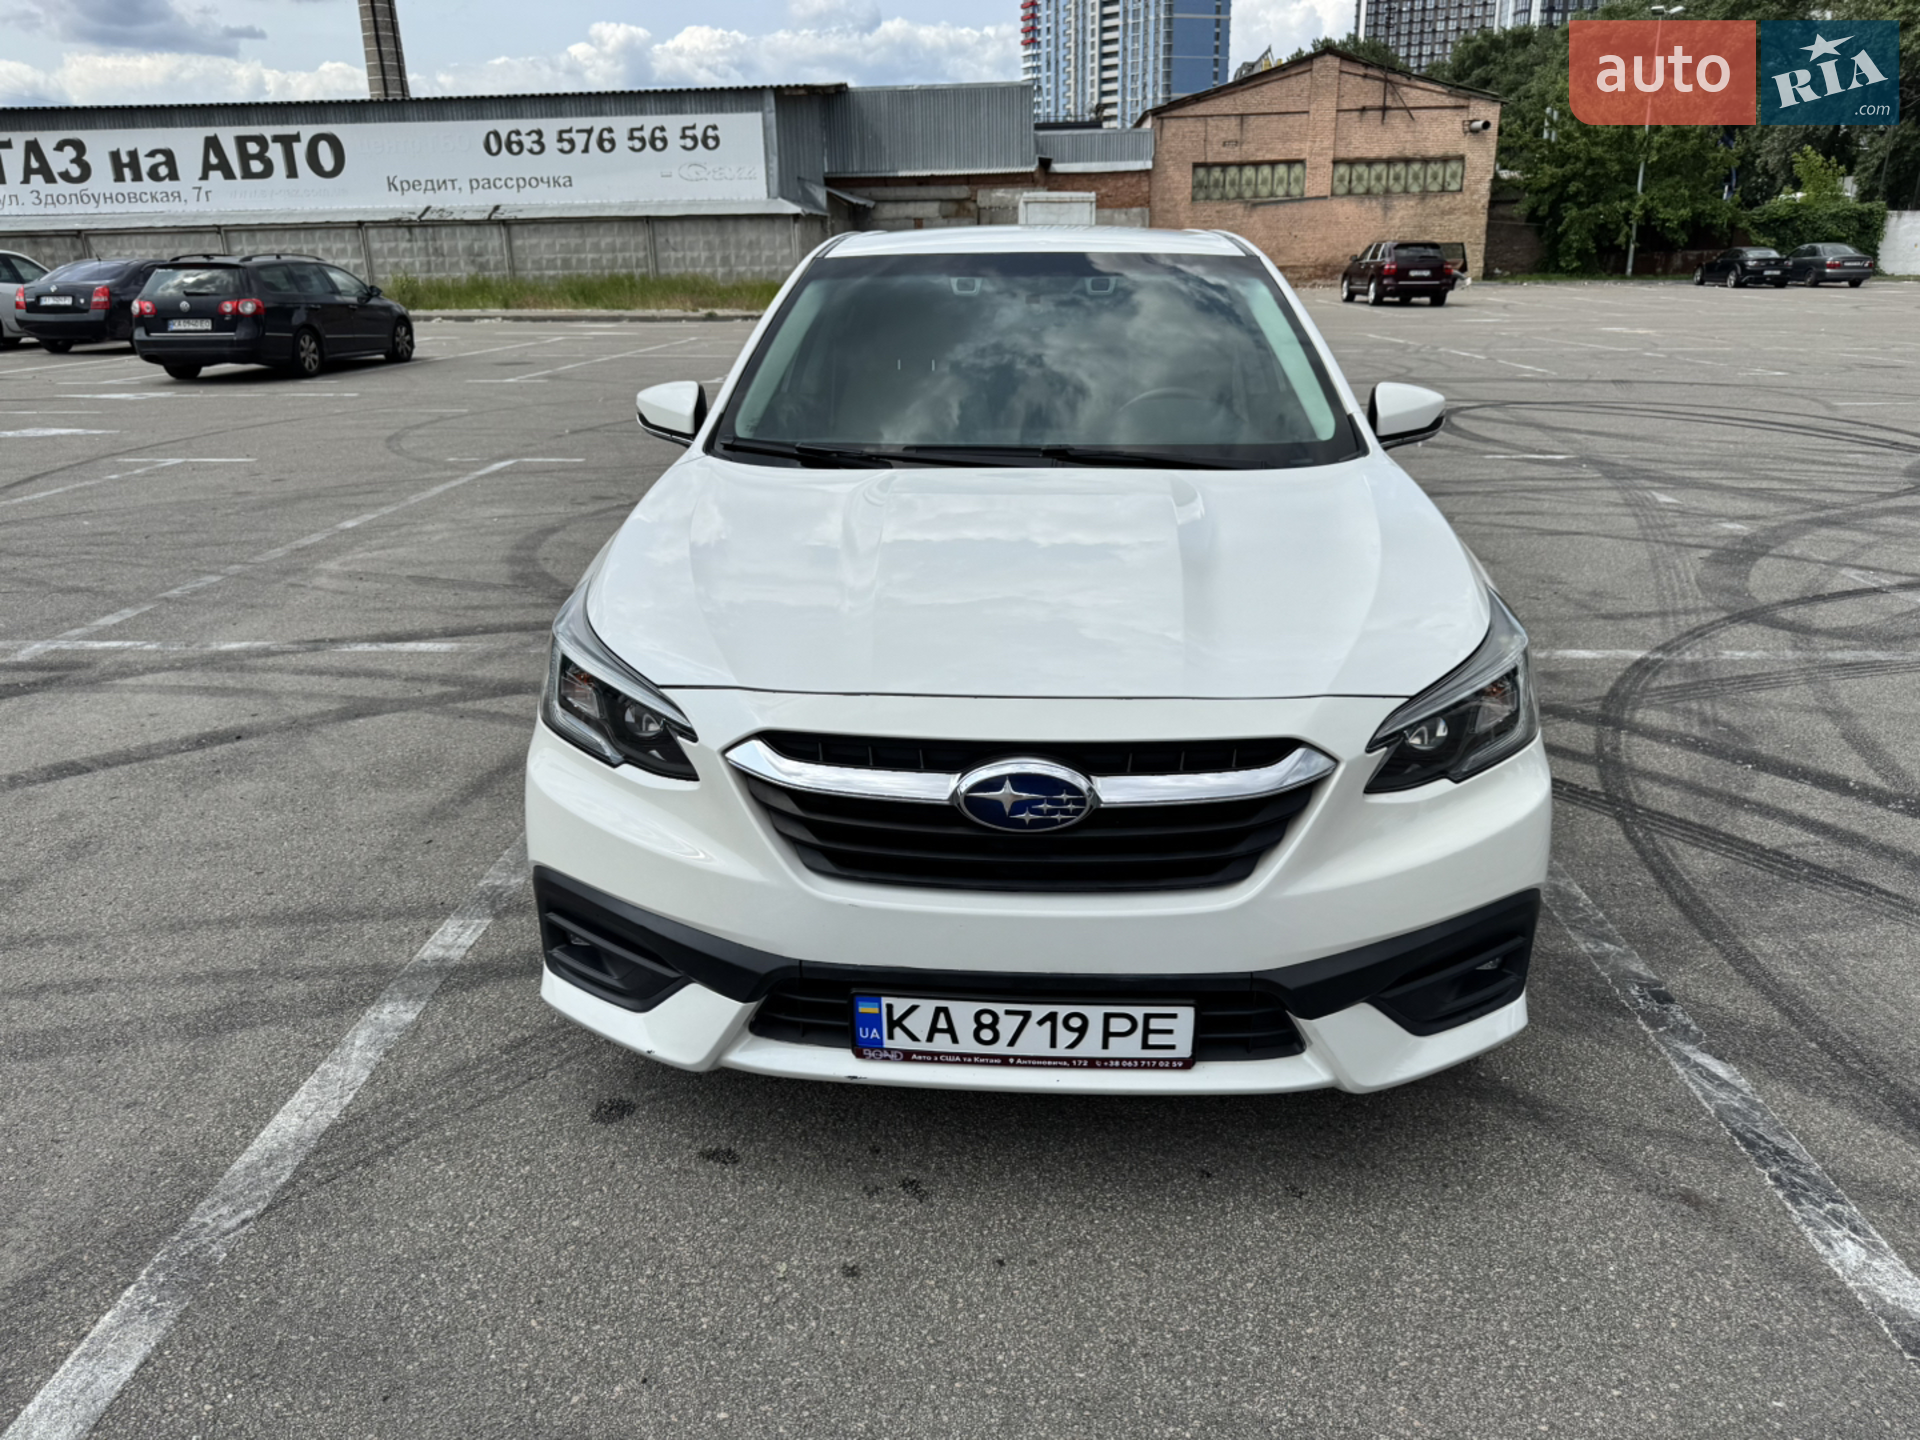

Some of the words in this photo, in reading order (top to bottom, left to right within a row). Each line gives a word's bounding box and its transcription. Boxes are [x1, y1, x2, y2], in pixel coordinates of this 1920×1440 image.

[483, 128, 546, 157] 063
[556, 126, 617, 155] 576
[627, 124, 669, 153] 56
[679, 123, 721, 152] 56
[108, 147, 181, 183] на
[199, 130, 346, 181] АВТО
[386, 175, 463, 195] Кредит,
[468, 174, 574, 194] рассрочка
[29, 188, 188, 209] Здолбуновская,
[192, 186, 213, 203] 7г
[859, 1027, 881, 1041] UA
[885, 1003, 960, 1045] KA
[972, 1008, 1089, 1050] 8719
[1101, 1012, 1179, 1051] PE
[940, 1054, 961, 1063] США
[1103, 1060, 1120, 1068] +38
[1121, 1060, 1138, 1068] 063
[1140, 1060, 1157, 1068] 717
[1158, 1060, 1170, 1068] 02
